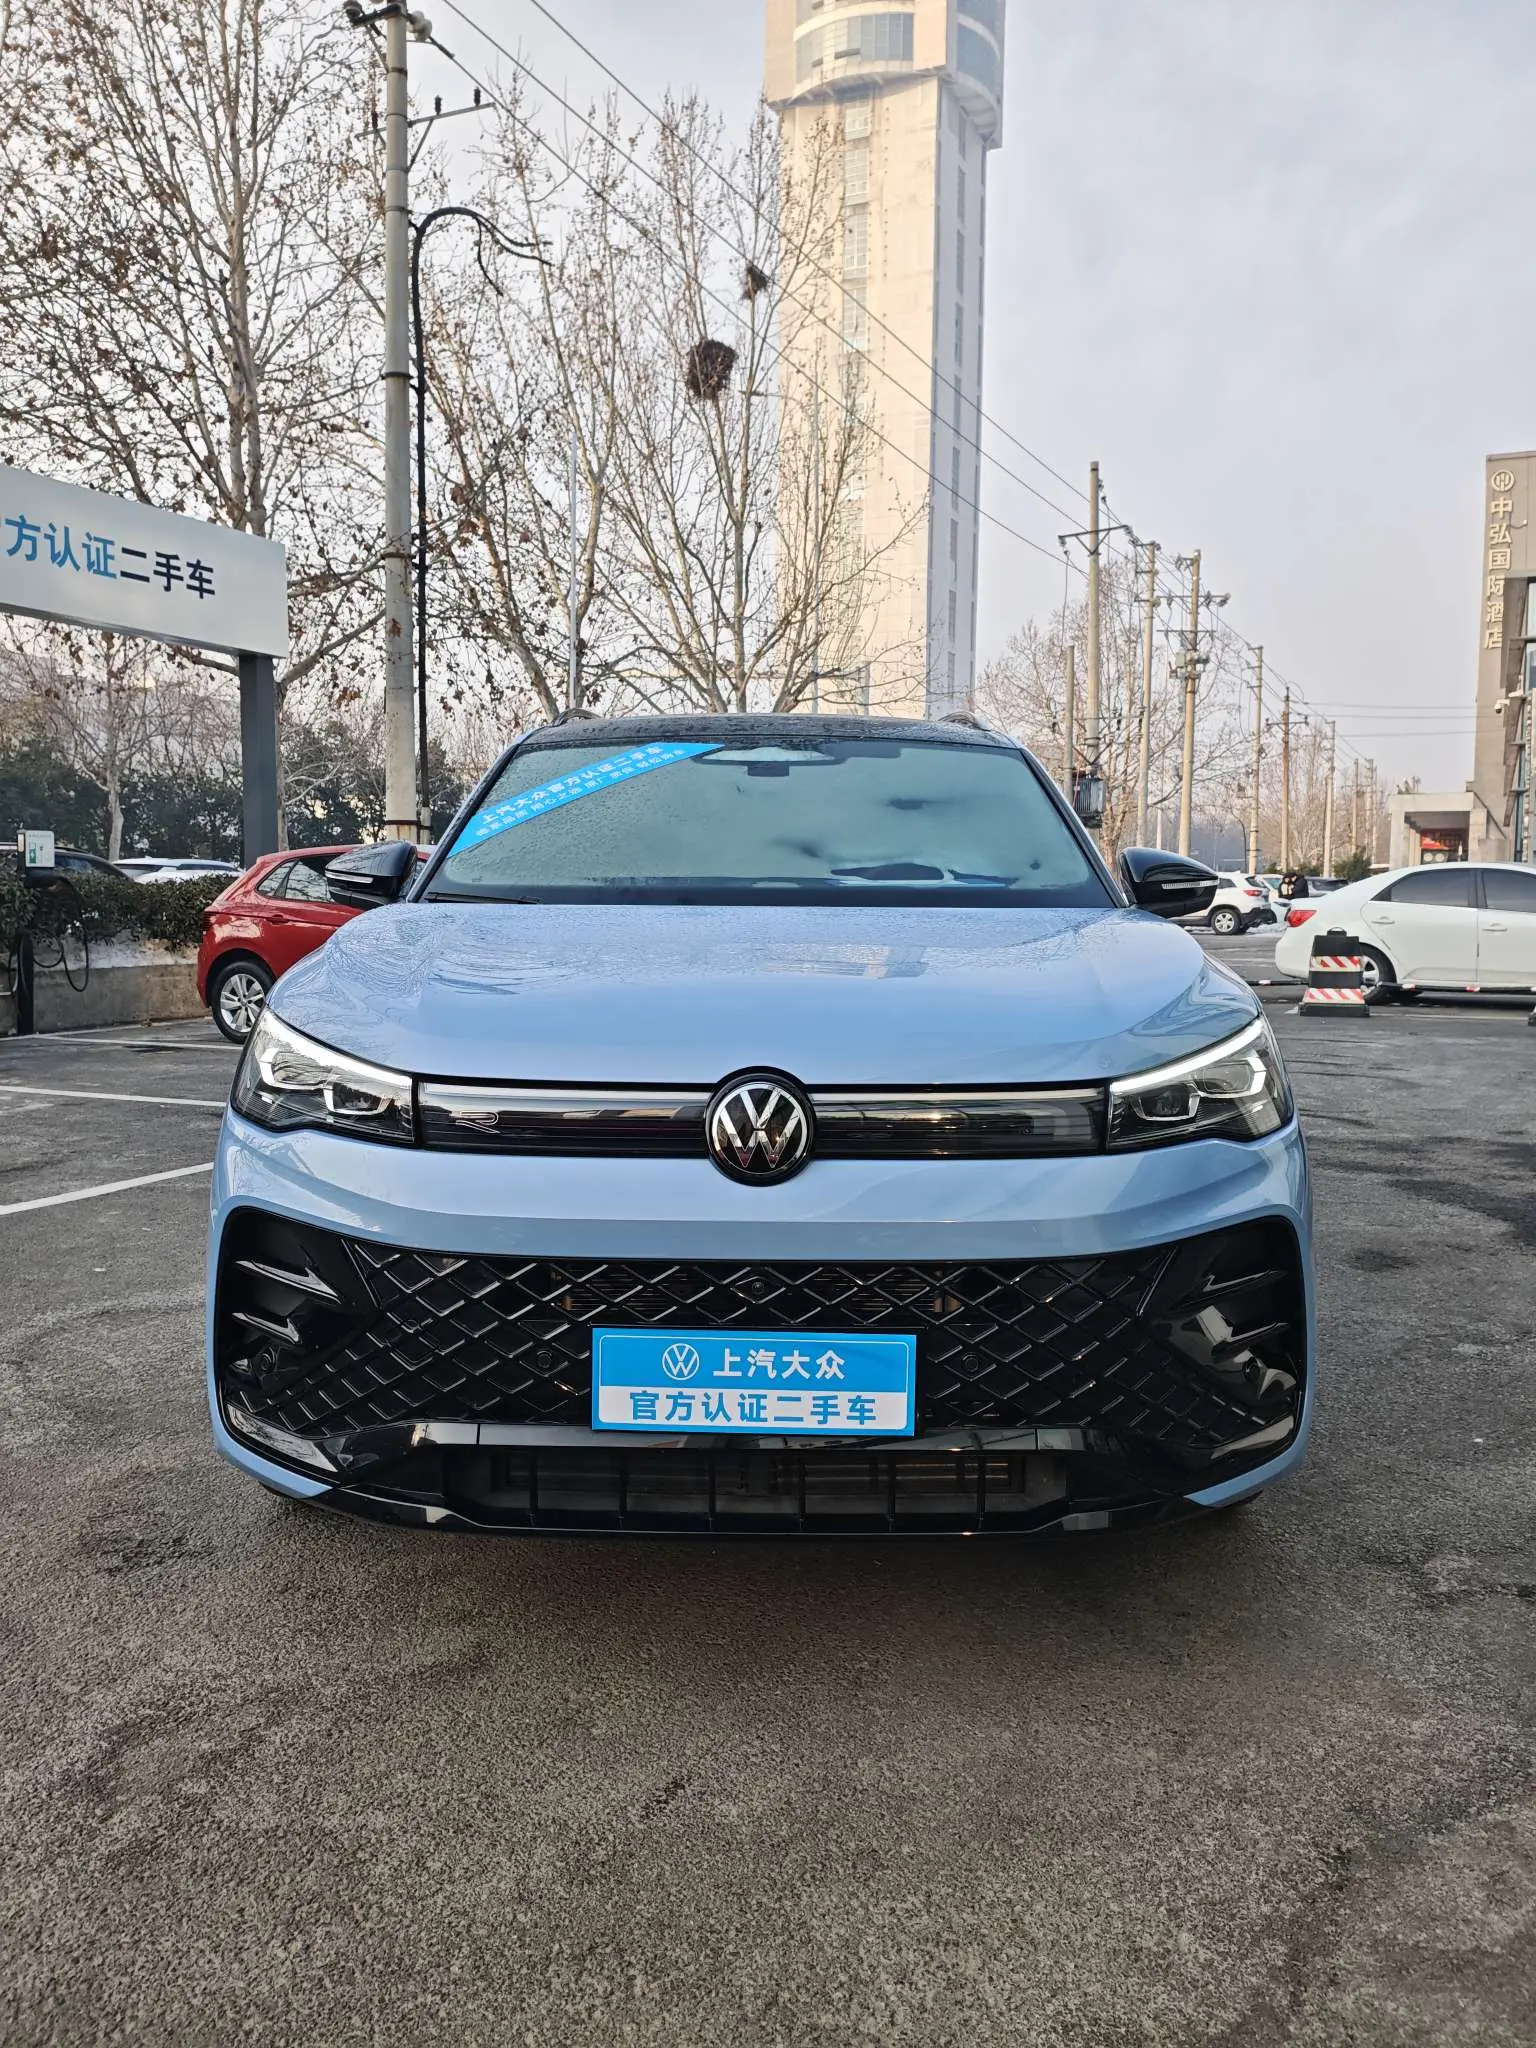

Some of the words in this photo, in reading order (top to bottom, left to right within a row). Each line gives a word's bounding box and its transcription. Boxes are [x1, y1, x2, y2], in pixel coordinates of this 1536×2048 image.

[1484, 497, 1513, 649] 中弘国际酒店
[713, 1348, 845, 1380] 上汽大众
[630, 1390, 876, 1425] 官方认证二手车
